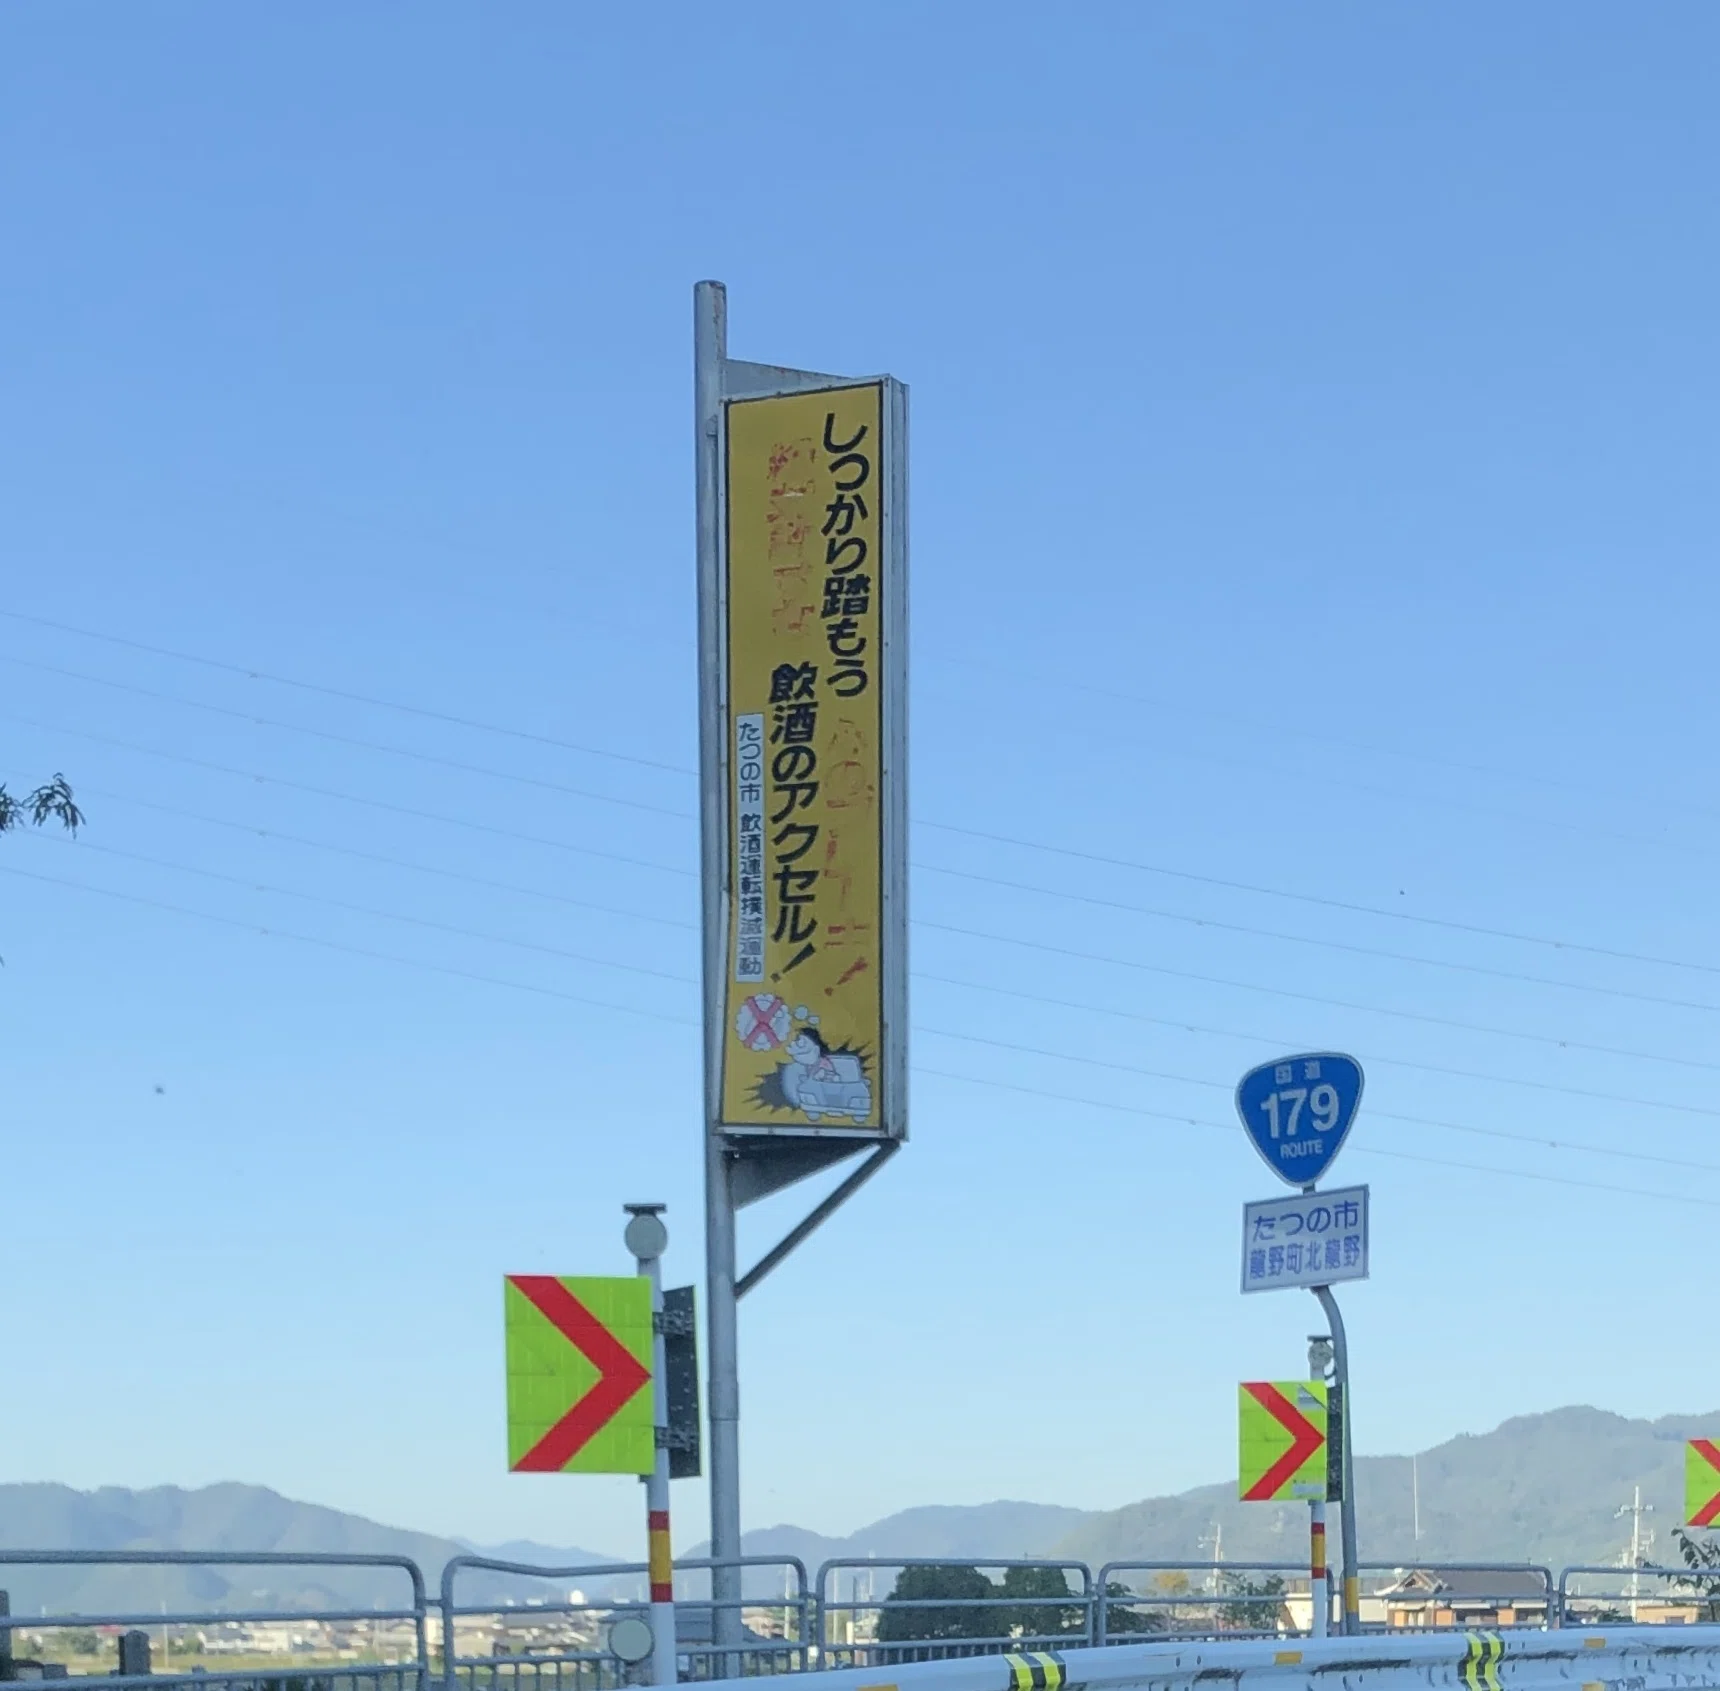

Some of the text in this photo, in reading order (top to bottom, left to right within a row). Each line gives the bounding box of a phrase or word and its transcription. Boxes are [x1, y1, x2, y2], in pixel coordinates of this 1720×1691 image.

[738, 722, 762, 803] たつの市
[1275, 1060, 1321, 1084] 国道
[1260, 1083, 1339, 1139] 179
[1280, 1139, 1324, 1160] ROUTE
[1253, 1200, 1360, 1243] たつの市
